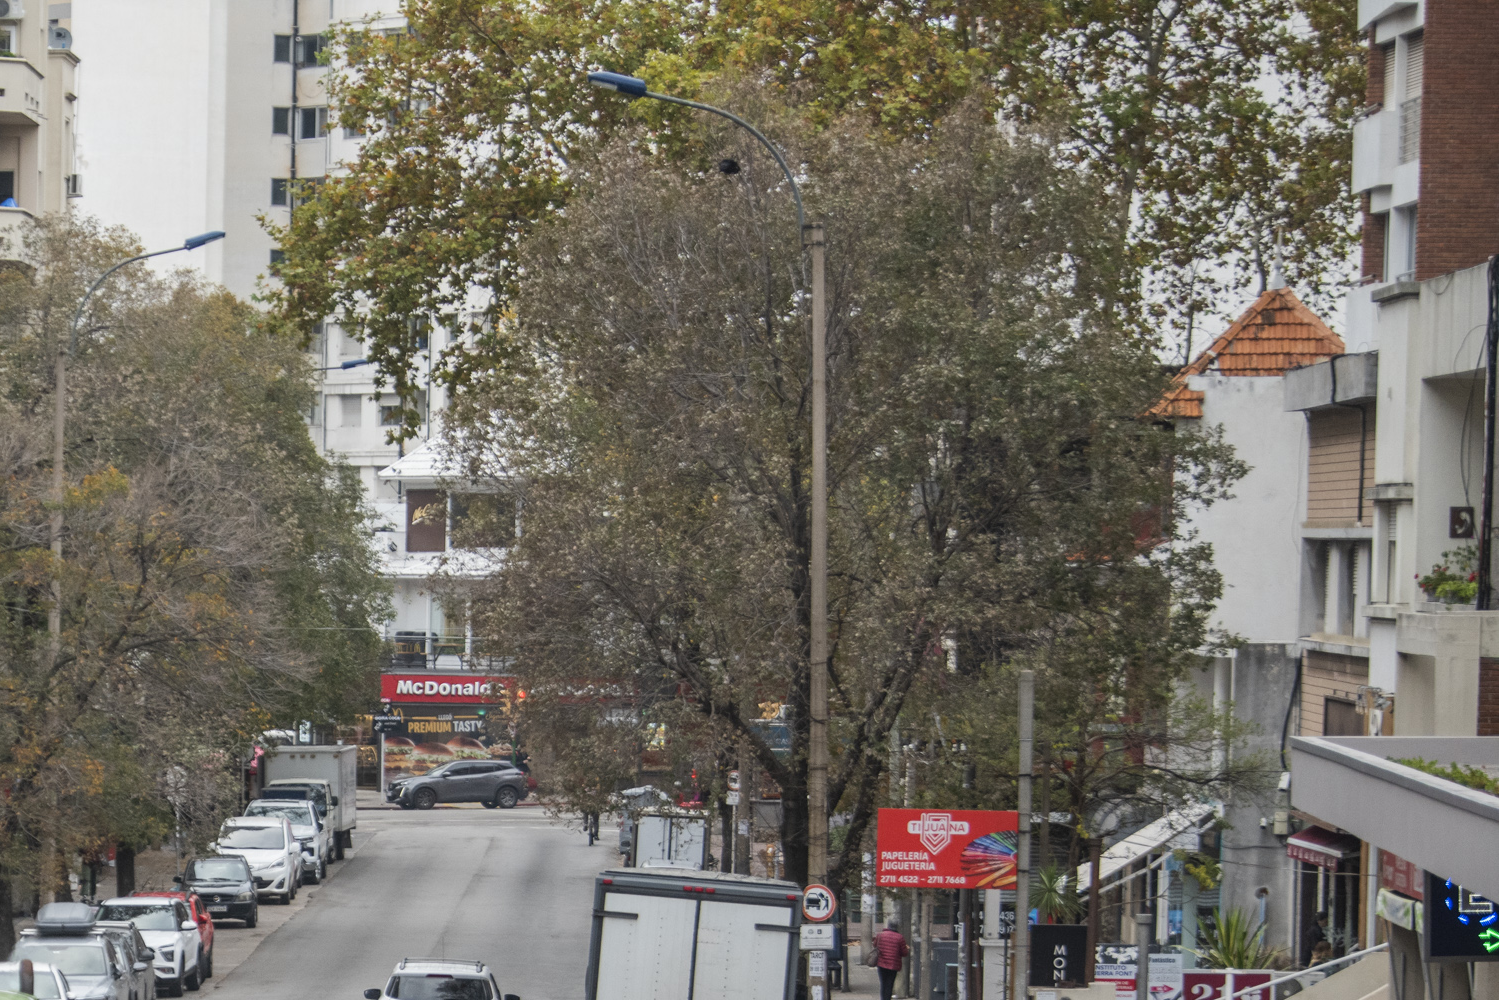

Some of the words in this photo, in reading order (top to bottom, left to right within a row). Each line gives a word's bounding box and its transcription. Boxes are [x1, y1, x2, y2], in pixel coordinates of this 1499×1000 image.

[408, 722, 452, 733] PREMIUM
[453, 720, 483, 733] TASTY
[910, 822, 965, 833] TIJUANA
[881, 850, 929, 860] PAPELERÍA
[880, 875, 896, 883] 2711
[897, 876, 918, 884] 4522
[927, 876, 943, 884] 2711
[944, 876, 966, 884] 7668
